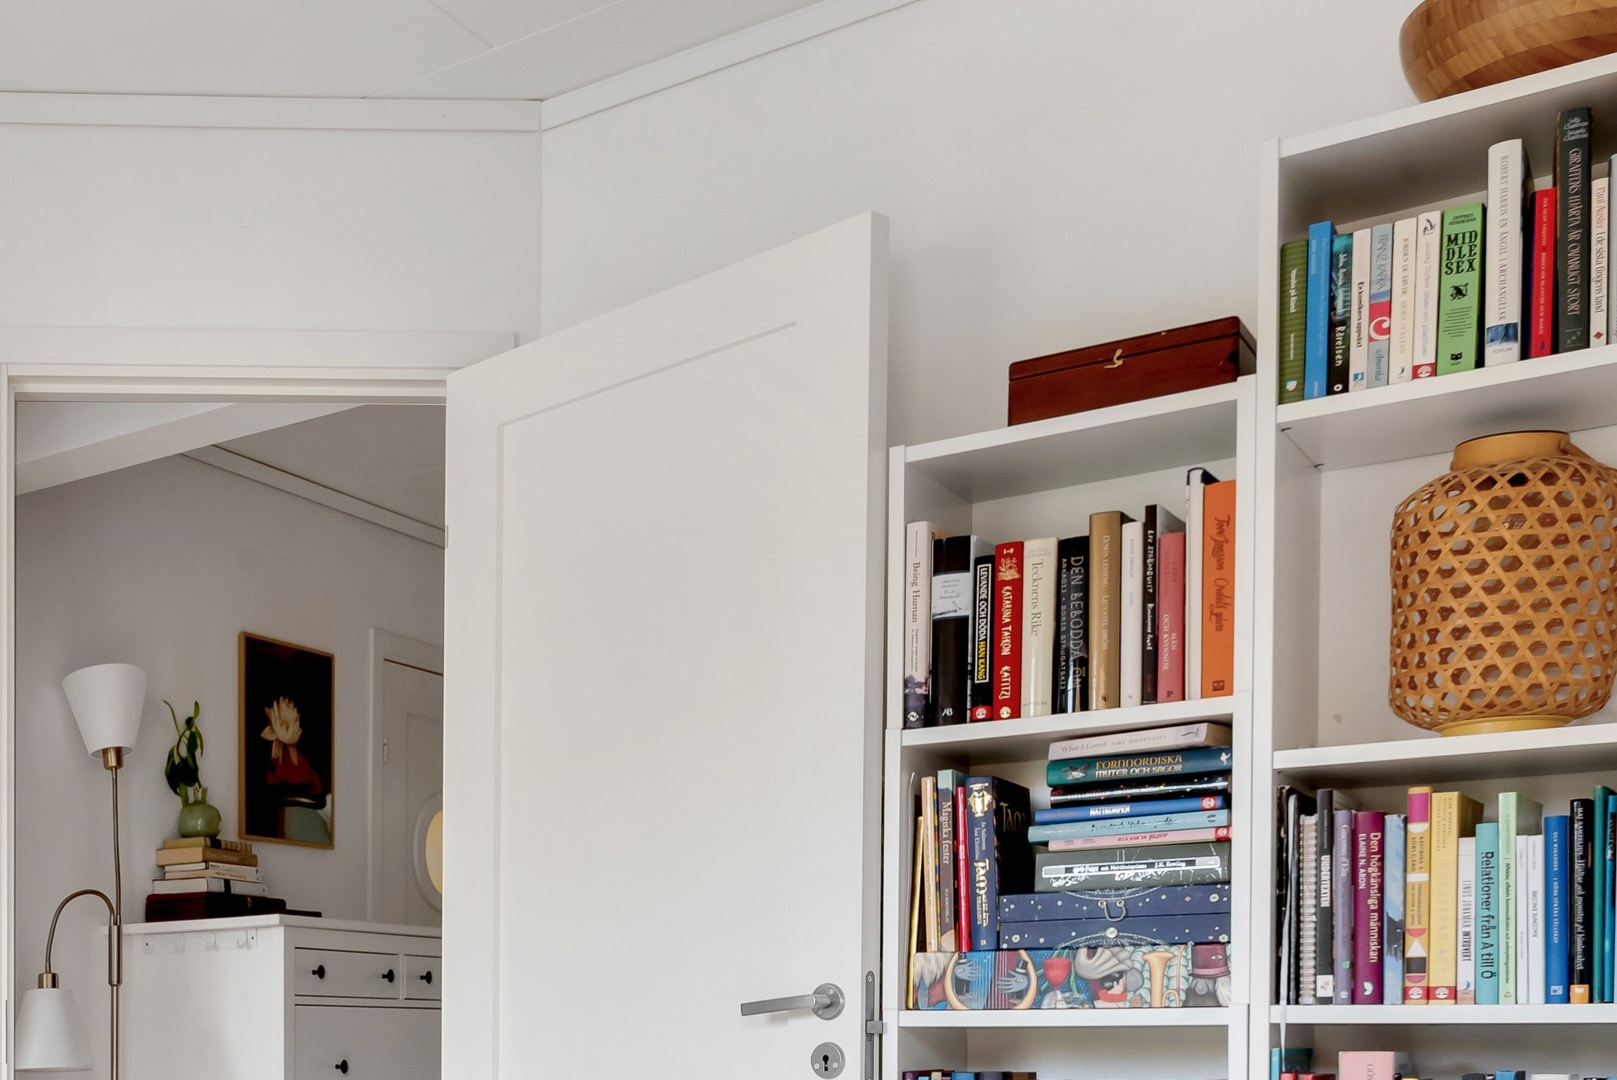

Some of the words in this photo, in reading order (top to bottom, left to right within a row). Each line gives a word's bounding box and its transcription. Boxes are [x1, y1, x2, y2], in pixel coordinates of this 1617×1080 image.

[1499, 155, 1509, 185] ROBERT
[1567, 148, 1582, 194] GIRAFFENS
[1499, 187, 1509, 217] HARRIS
[1596, 187, 1607, 204] Paul
[1499, 218, 1508, 230] EN
[1567, 196, 1583, 228] HJÄRTA
[1595, 205, 1606, 230] Auster
[1376, 233, 1389, 262] FRANZ
[1445, 232, 1479, 245] MID
[1498, 231, 1511, 256] ÄNGEL
[1568, 229, 1584, 242] ÄR
[1595, 236, 1605, 246] de
[1444, 246, 1477, 259] DLE
[1566, 243, 1581, 286] OVANLIGT
[1594, 247, 1606, 265] sista
[1375, 264, 1387, 292] KAFKA
[1444, 259, 1476, 276] SEX
[1357, 281, 1364, 291] En
[1497, 263, 1508, 321] ARCHANGELSK
[1592, 266, 1606, 295] tingens
[1356, 292, 1364, 321] komikers
[1566, 288, 1580, 317] STORT
[1594, 295, 1605, 314] land
[1334, 326, 1346, 366] Rörelsen
[1101, 535, 1110, 558] DORIS
[911, 562, 921, 587] Being
[978, 568, 988, 600] LEVANDE
[1031, 559, 1044, 610] Tecknens
[1060, 558, 1068, 594] ARKADIJ
[1101, 559, 1110, 587] LESSING
[911, 589, 921, 623] Human
[979, 601, 987, 618] OCH
[1001, 585, 1014, 623] KATARINA
[978, 619, 988, 641] DÖDA
[1030, 612, 1042, 637] Rike
[1162, 614, 1170, 632] OCH
[978, 641, 987, 658] HAN
[1000, 625, 1012, 656] TAIKON
[1161, 634, 1170, 671] KVINNOR
[1170, 632, 1178, 651] MÄN
[977, 659, 986, 680] KANG
[1059, 634, 1067, 690] STRUGATSKIJ
[999, 665, 1011, 700] KATITZI
[942, 708, 954, 717] AB
[1061, 744, 1080, 753] What
[1084, 740, 1107, 751] Loved
[1095, 754, 1183, 770] FORNNORDISKA
[1095, 768, 1128, 779] MYTER
[1130, 767, 1151, 776] OCH
[1152, 765, 1183, 775] SAGOR
[940, 801, 952, 839] Magiska
[942, 840, 951, 864] fester
[1341, 824, 1349, 856] Giacomo
[1358, 833, 1366, 858] ELAINE
[1369, 832, 1381, 853] Den
[1358, 859, 1366, 867] N.
[1320, 854, 1331, 907] UNDERTEXTEN
[1358, 868, 1366, 889] ARON
[1368, 855, 1381, 910] högkänsliga
[1462, 880, 1472, 898] LINUS
[1480, 851, 1495, 912] Relationer
[1461, 899, 1472, 928] JONKMAN
[1368, 912, 1381, 963] människan
[1480, 914, 1496, 940] från
[1461, 930, 1471, 962] INTROVERT
[1480, 941, 1493, 950] A
[1481, 952, 1495, 967] till
[1480, 970, 1496, 980] Ö
